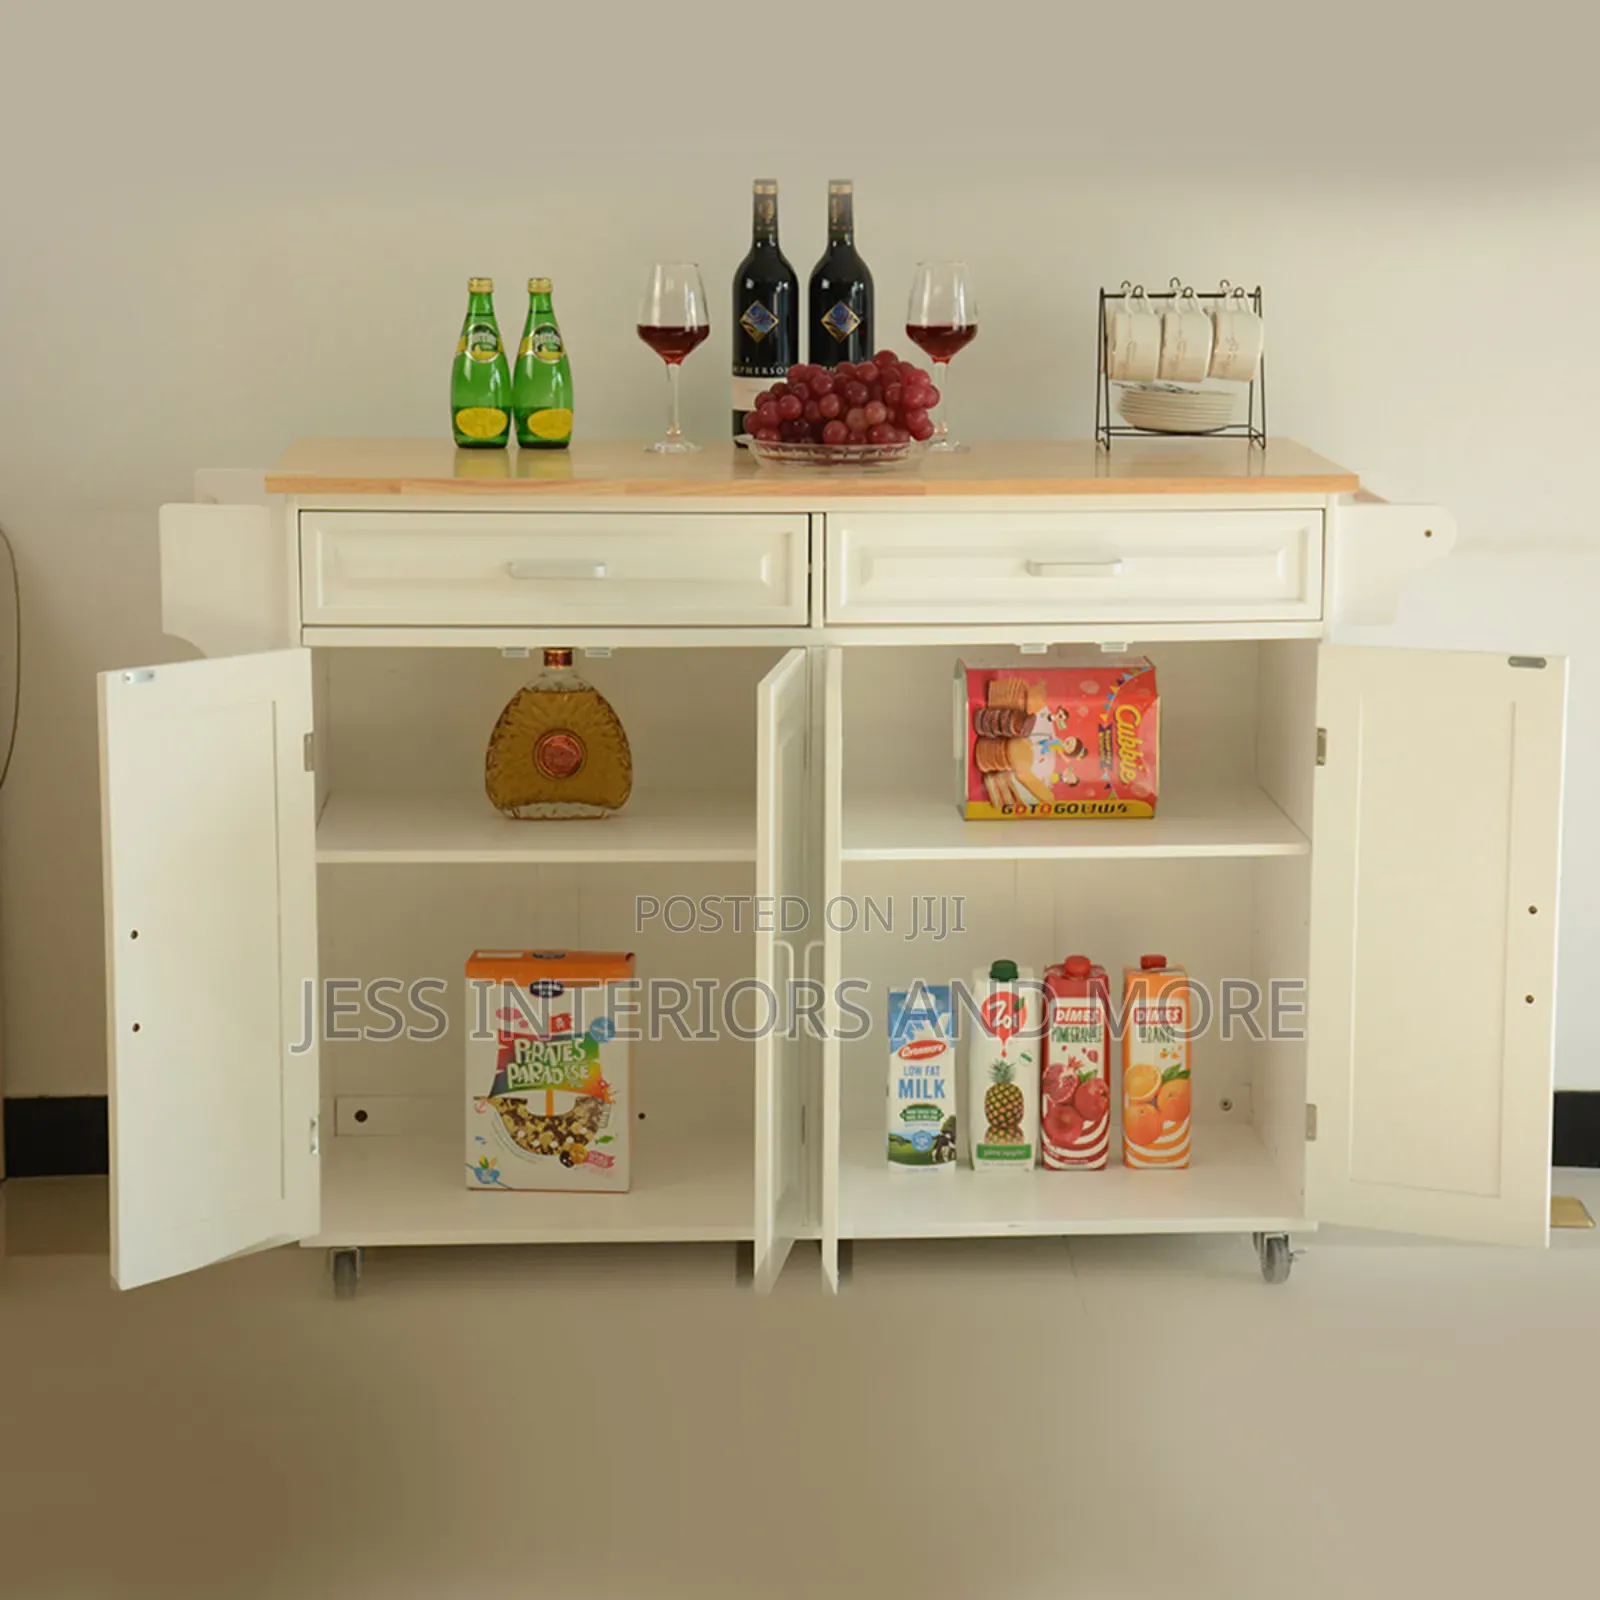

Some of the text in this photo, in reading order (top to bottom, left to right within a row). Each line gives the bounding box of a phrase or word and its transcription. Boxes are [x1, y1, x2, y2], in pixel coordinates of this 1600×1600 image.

[1115, 704, 1144, 784] Cubbie
[514, 1038, 586, 1066] PIRATES
[507, 1062, 589, 1089] PARADISE
[903, 1065, 940, 1076] LOW FAT
[898, 1079, 945, 1099] MILK
